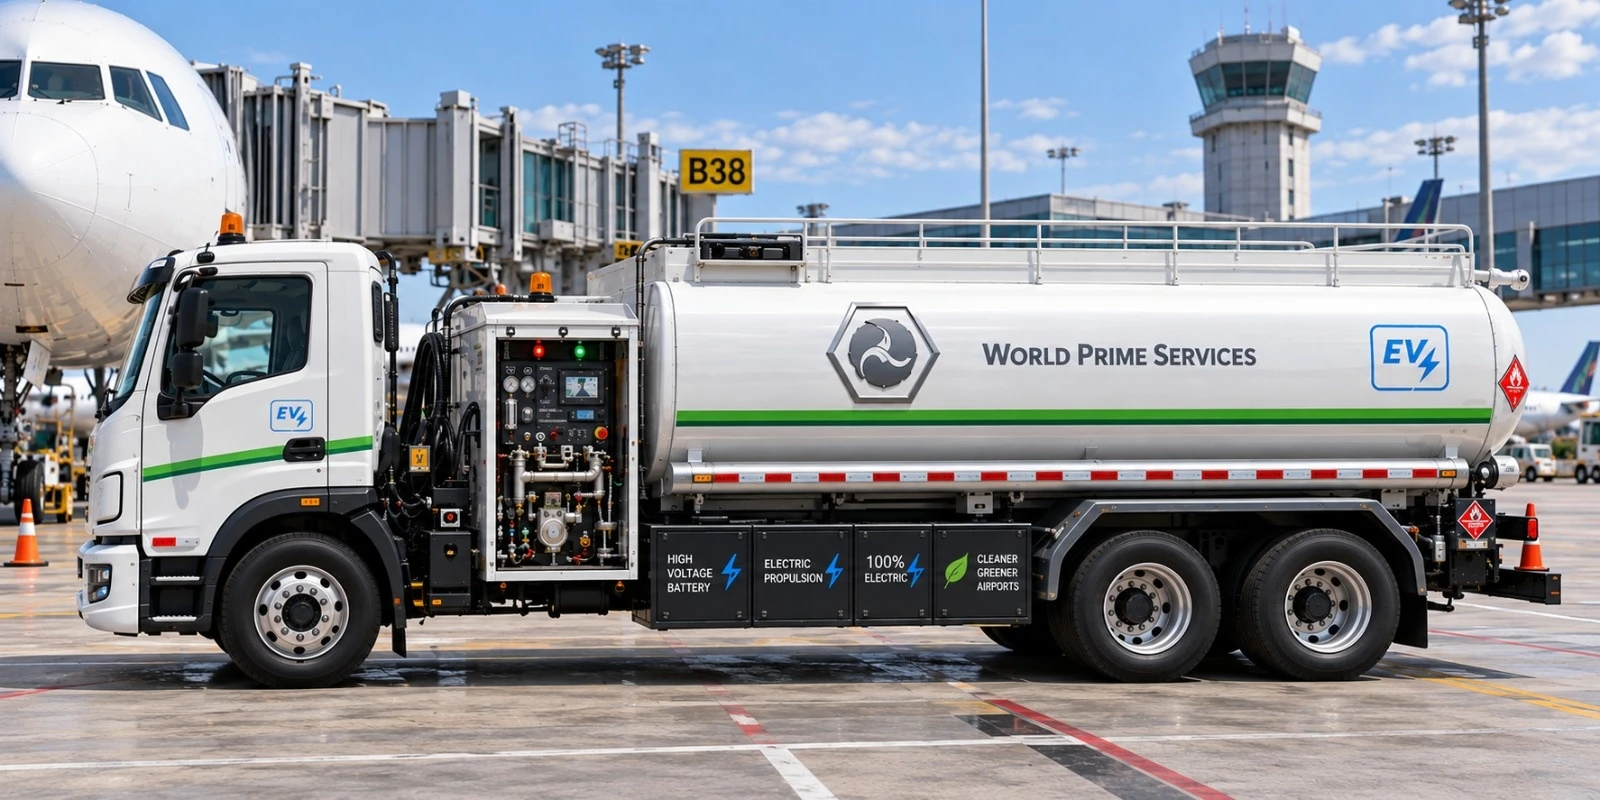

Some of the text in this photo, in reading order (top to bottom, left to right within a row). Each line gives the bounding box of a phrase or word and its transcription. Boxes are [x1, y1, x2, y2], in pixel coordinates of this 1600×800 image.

[688, 157, 745, 185] B38
[1382, 338, 1429, 364] EV
[276, 406, 303, 419] EV
[667, 554, 693, 565] HIGH
[764, 558, 811, 569] ELECTRIC
[866, 554, 905, 569] 100%
[976, 554, 1018, 564] CLEANER
[667, 568, 713, 579] VOLTAGE
[764, 573, 823, 584] PROPULSION
[864, 572, 908, 583] ELECTRIC
[976, 568, 1018, 578] GREENER
[667, 582, 711, 593] BATTERY
[976, 581, 1020, 591] AIRPORTS
